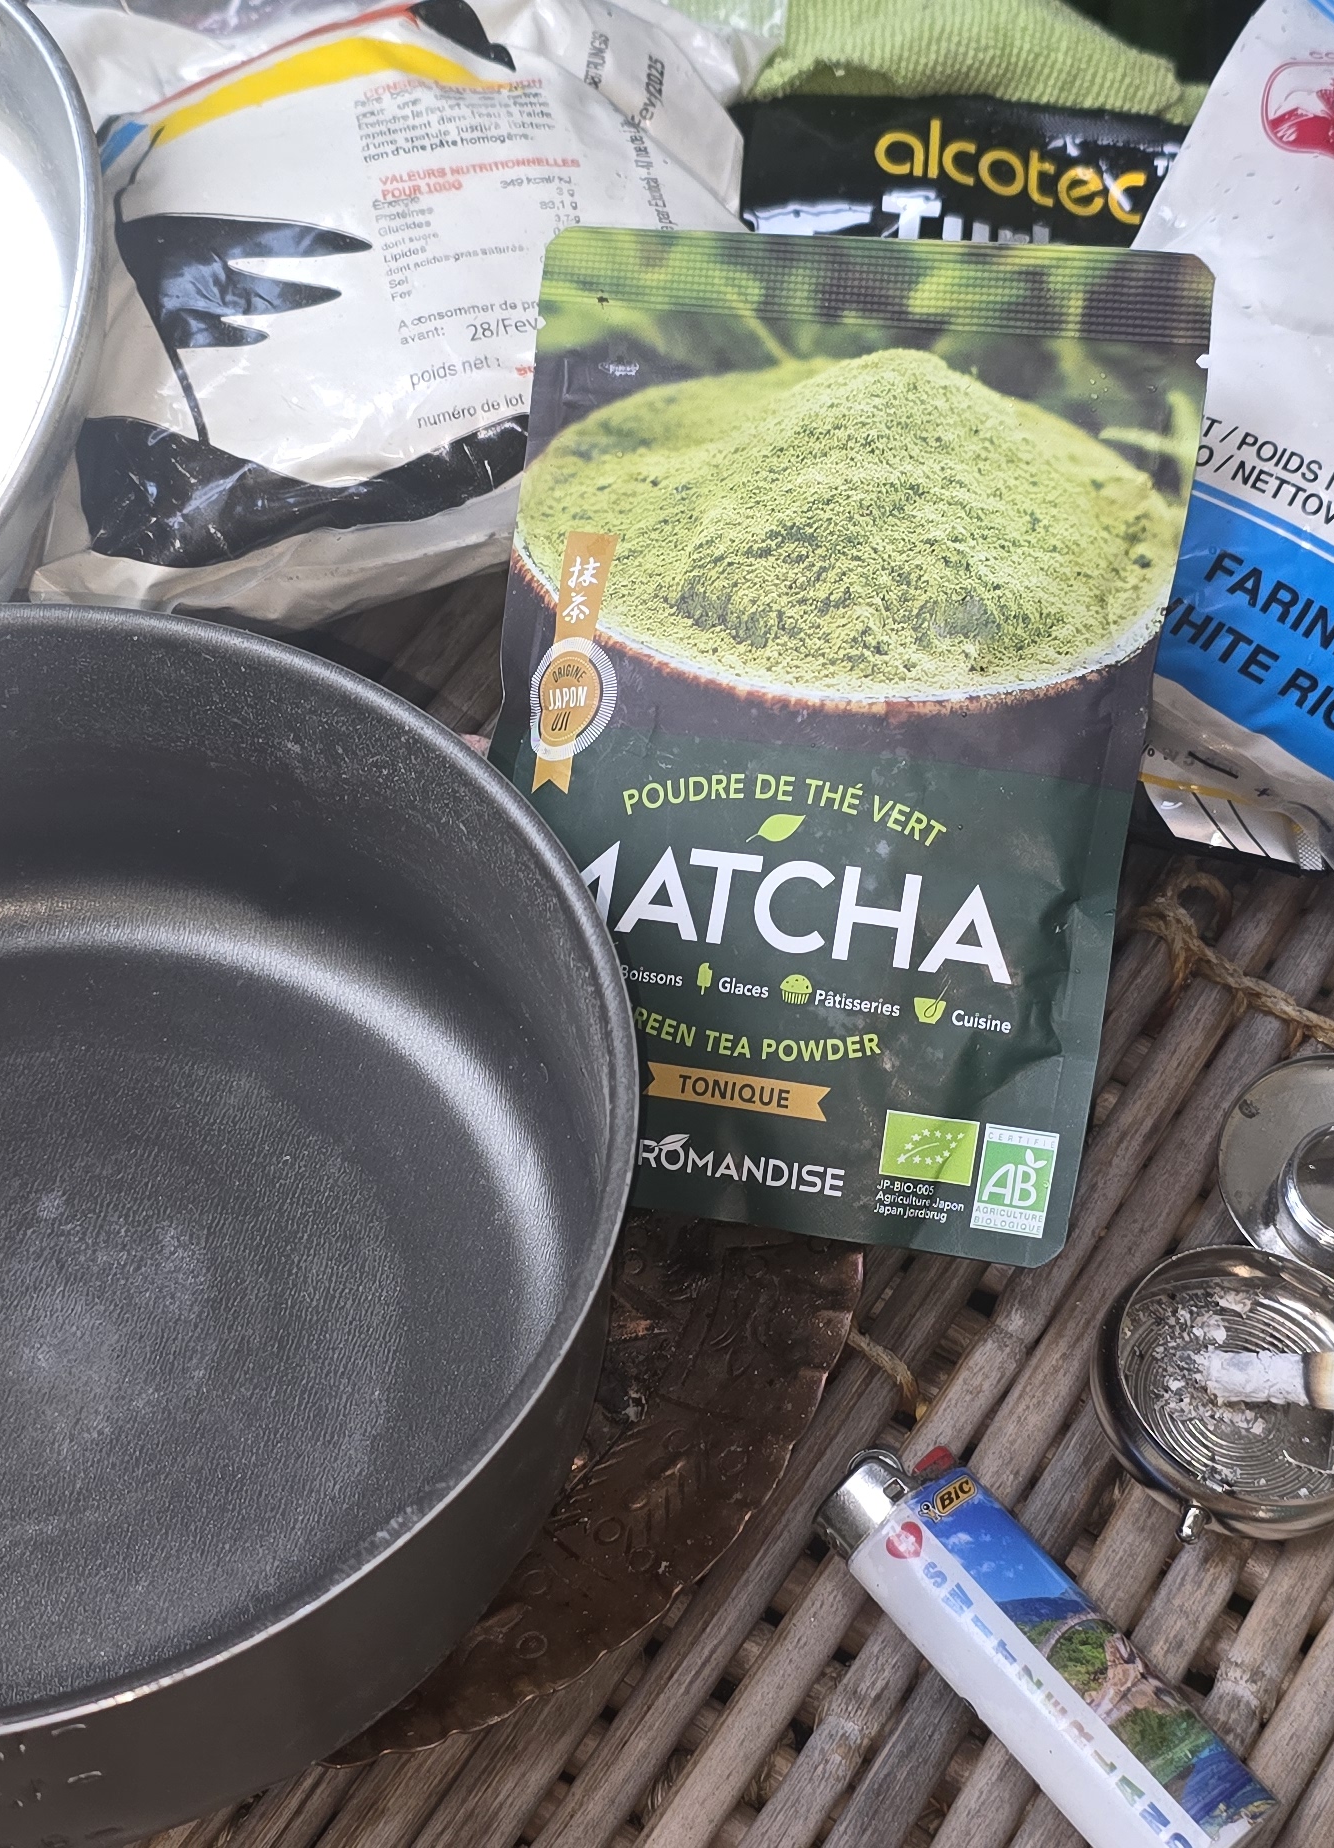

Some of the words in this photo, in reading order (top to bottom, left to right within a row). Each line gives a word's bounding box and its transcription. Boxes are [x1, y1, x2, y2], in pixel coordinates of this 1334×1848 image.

[437, 114, 467, 126] dans
[404, 129, 451, 145] spatule
[363, 151, 389, 163] tion
[391, 143, 427, 157] d'une
[430, 138, 458, 152] pâte
[379, 167, 447, 186] VALEURS
[449, 157, 581, 176] NUTRITIONNELLES
[500, 178, 524, 189] 349
[874, 117, 1147, 226] alcotec
[381, 184, 424, 201] POUR
[375, 207, 435, 224] Protéines
[378, 220, 432, 237] Glucides
[384, 245, 427, 263] Lipides
[398, 319, 409, 332] A
[411, 302, 496, 326] consommer
[498, 300, 518, 312] de
[400, 325, 446, 346] avant:
[466, 316, 539, 342] 28/Fev
[409, 362, 458, 389] poids
[463, 355, 490, 375] net
[418, 404, 478, 429] numéro
[481, 398, 501, 413] de
[505, 393, 526, 410] lot
[1236, 432, 1323, 483] POIDS
[562, 555, 601, 624] 抹茶
[551, 663, 587, 683] ORIGINE
[549, 686, 588, 711] JAPON
[551, 711, 572, 732] UJI
[622, 773, 745, 816] POUDRE
[754, 773, 796, 801] DE
[805, 778, 864, 815] THÉ
[872, 794, 947, 847] VERT
[718, 975, 769, 999] Glaces
[814, 988, 901, 1018] Pâtisseries
[951, 1009, 1013, 1035] Cuisine
[633, 1008, 697, 1047] REEN
[704, 1030, 751, 1059] TEA
[761, 1032, 882, 1063] POWDER
[678, 1074, 791, 1110] TONIQUE
[637, 1136, 846, 1197] ROMANDISE
[877, 1179, 934, 1195] JP-BIO-005
[982, 1163, 1037, 1207] AB
[874, 1203, 903, 1216] Japan
[875, 1190, 931, 1207] Agriculture
[932, 1197, 965, 1212] Japon
[973, 1216, 1042, 1233] BIOLOGIQUE
[975, 1206, 1043, 1223] AGRICULTURE
